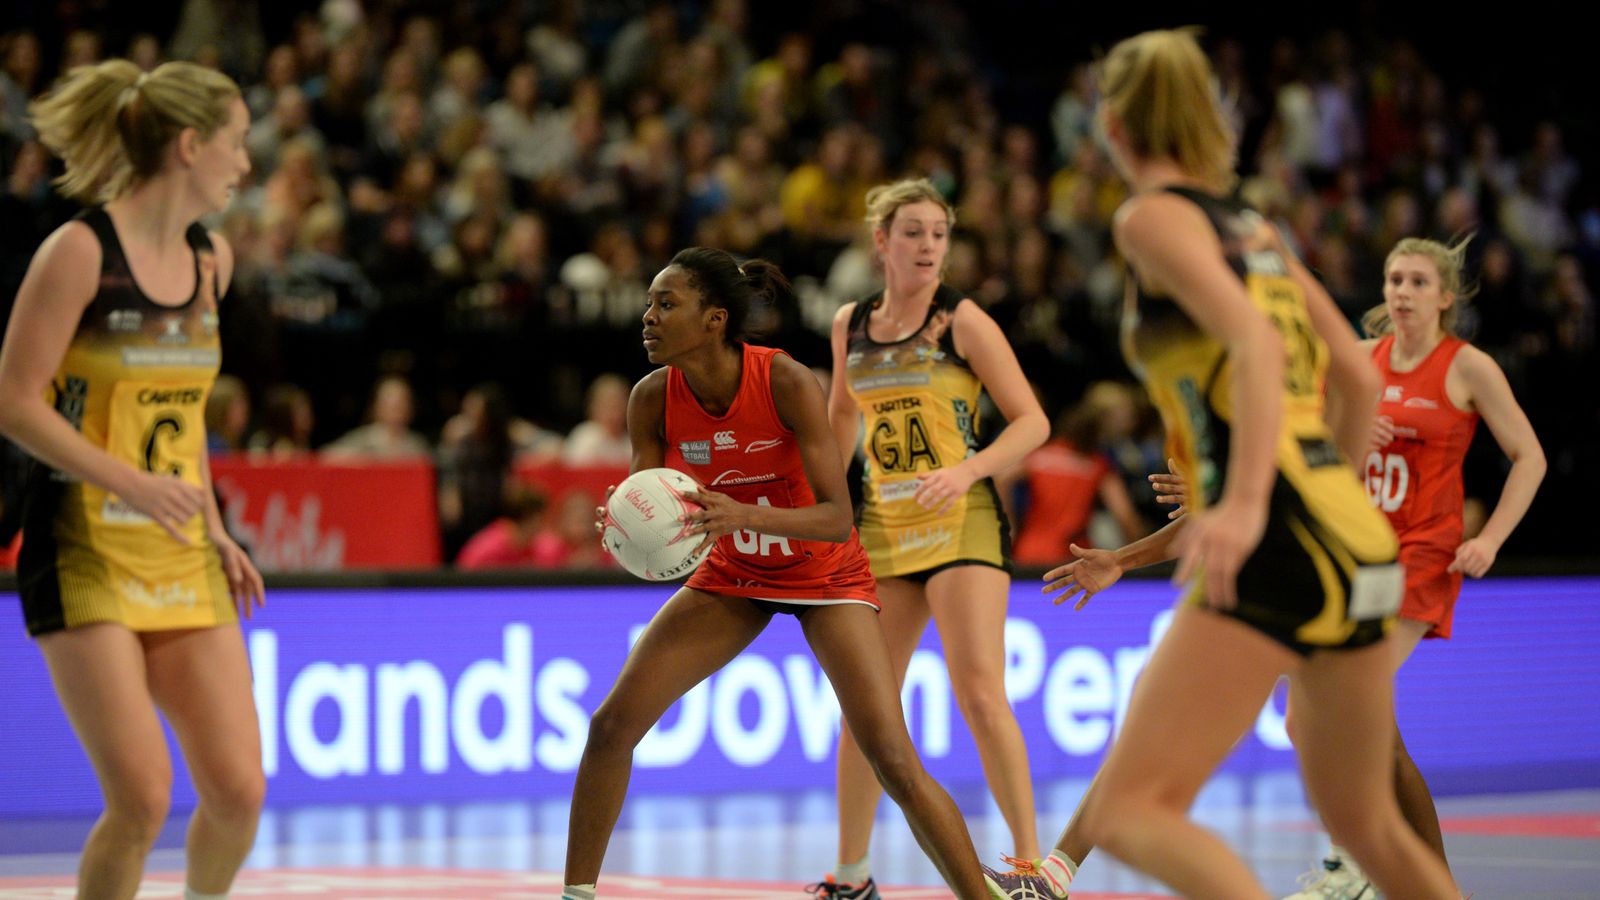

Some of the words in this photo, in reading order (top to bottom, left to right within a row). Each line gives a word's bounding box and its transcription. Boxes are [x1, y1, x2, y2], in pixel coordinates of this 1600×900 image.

[139, 408, 187, 476] C
[871, 412, 942, 475] GA
[624, 487, 656, 522] Vitality
[719, 473, 776, 485] northumbria
[1365, 450, 1409, 513] GD
